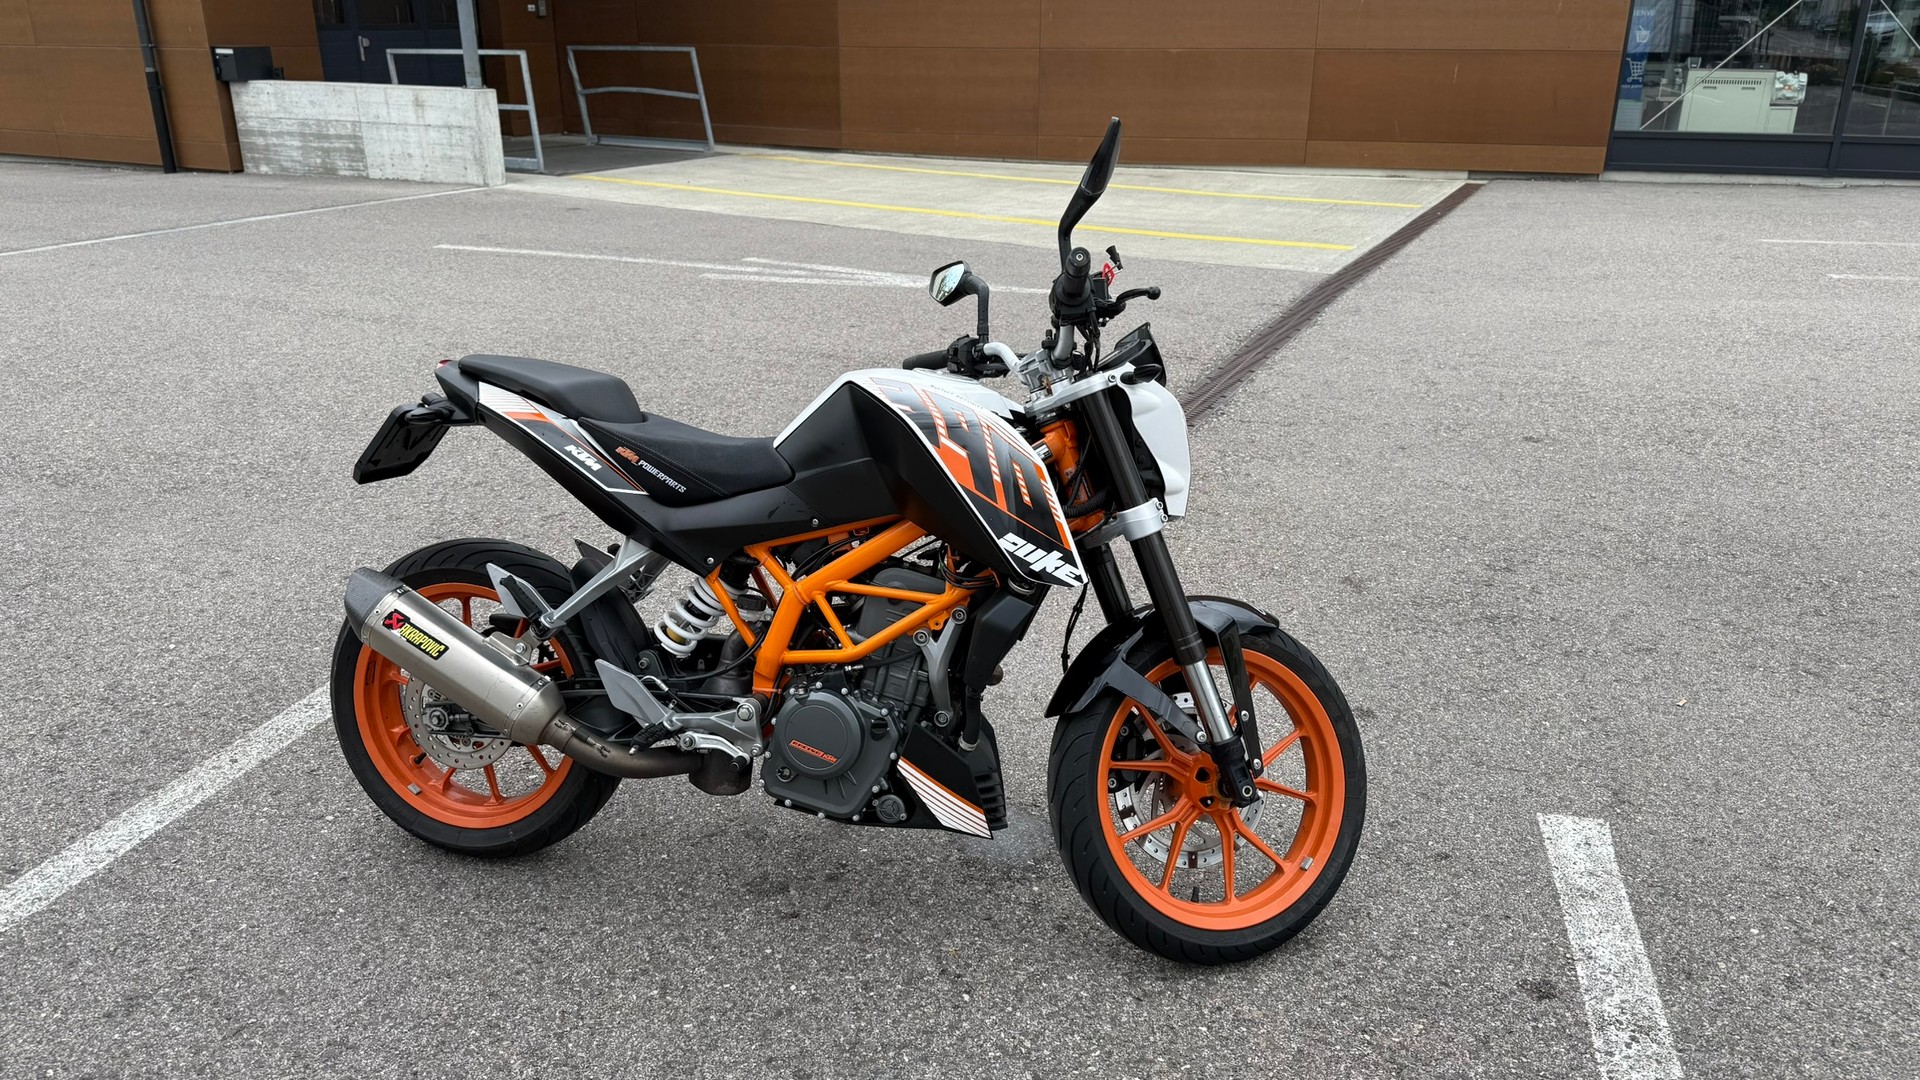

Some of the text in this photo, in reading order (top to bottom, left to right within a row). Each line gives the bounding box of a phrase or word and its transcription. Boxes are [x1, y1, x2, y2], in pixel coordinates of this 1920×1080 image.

[563, 444, 602, 471] KTM
[638, 460, 687, 493] POWERPARTS
[998, 532, 1082, 587] DUKE
